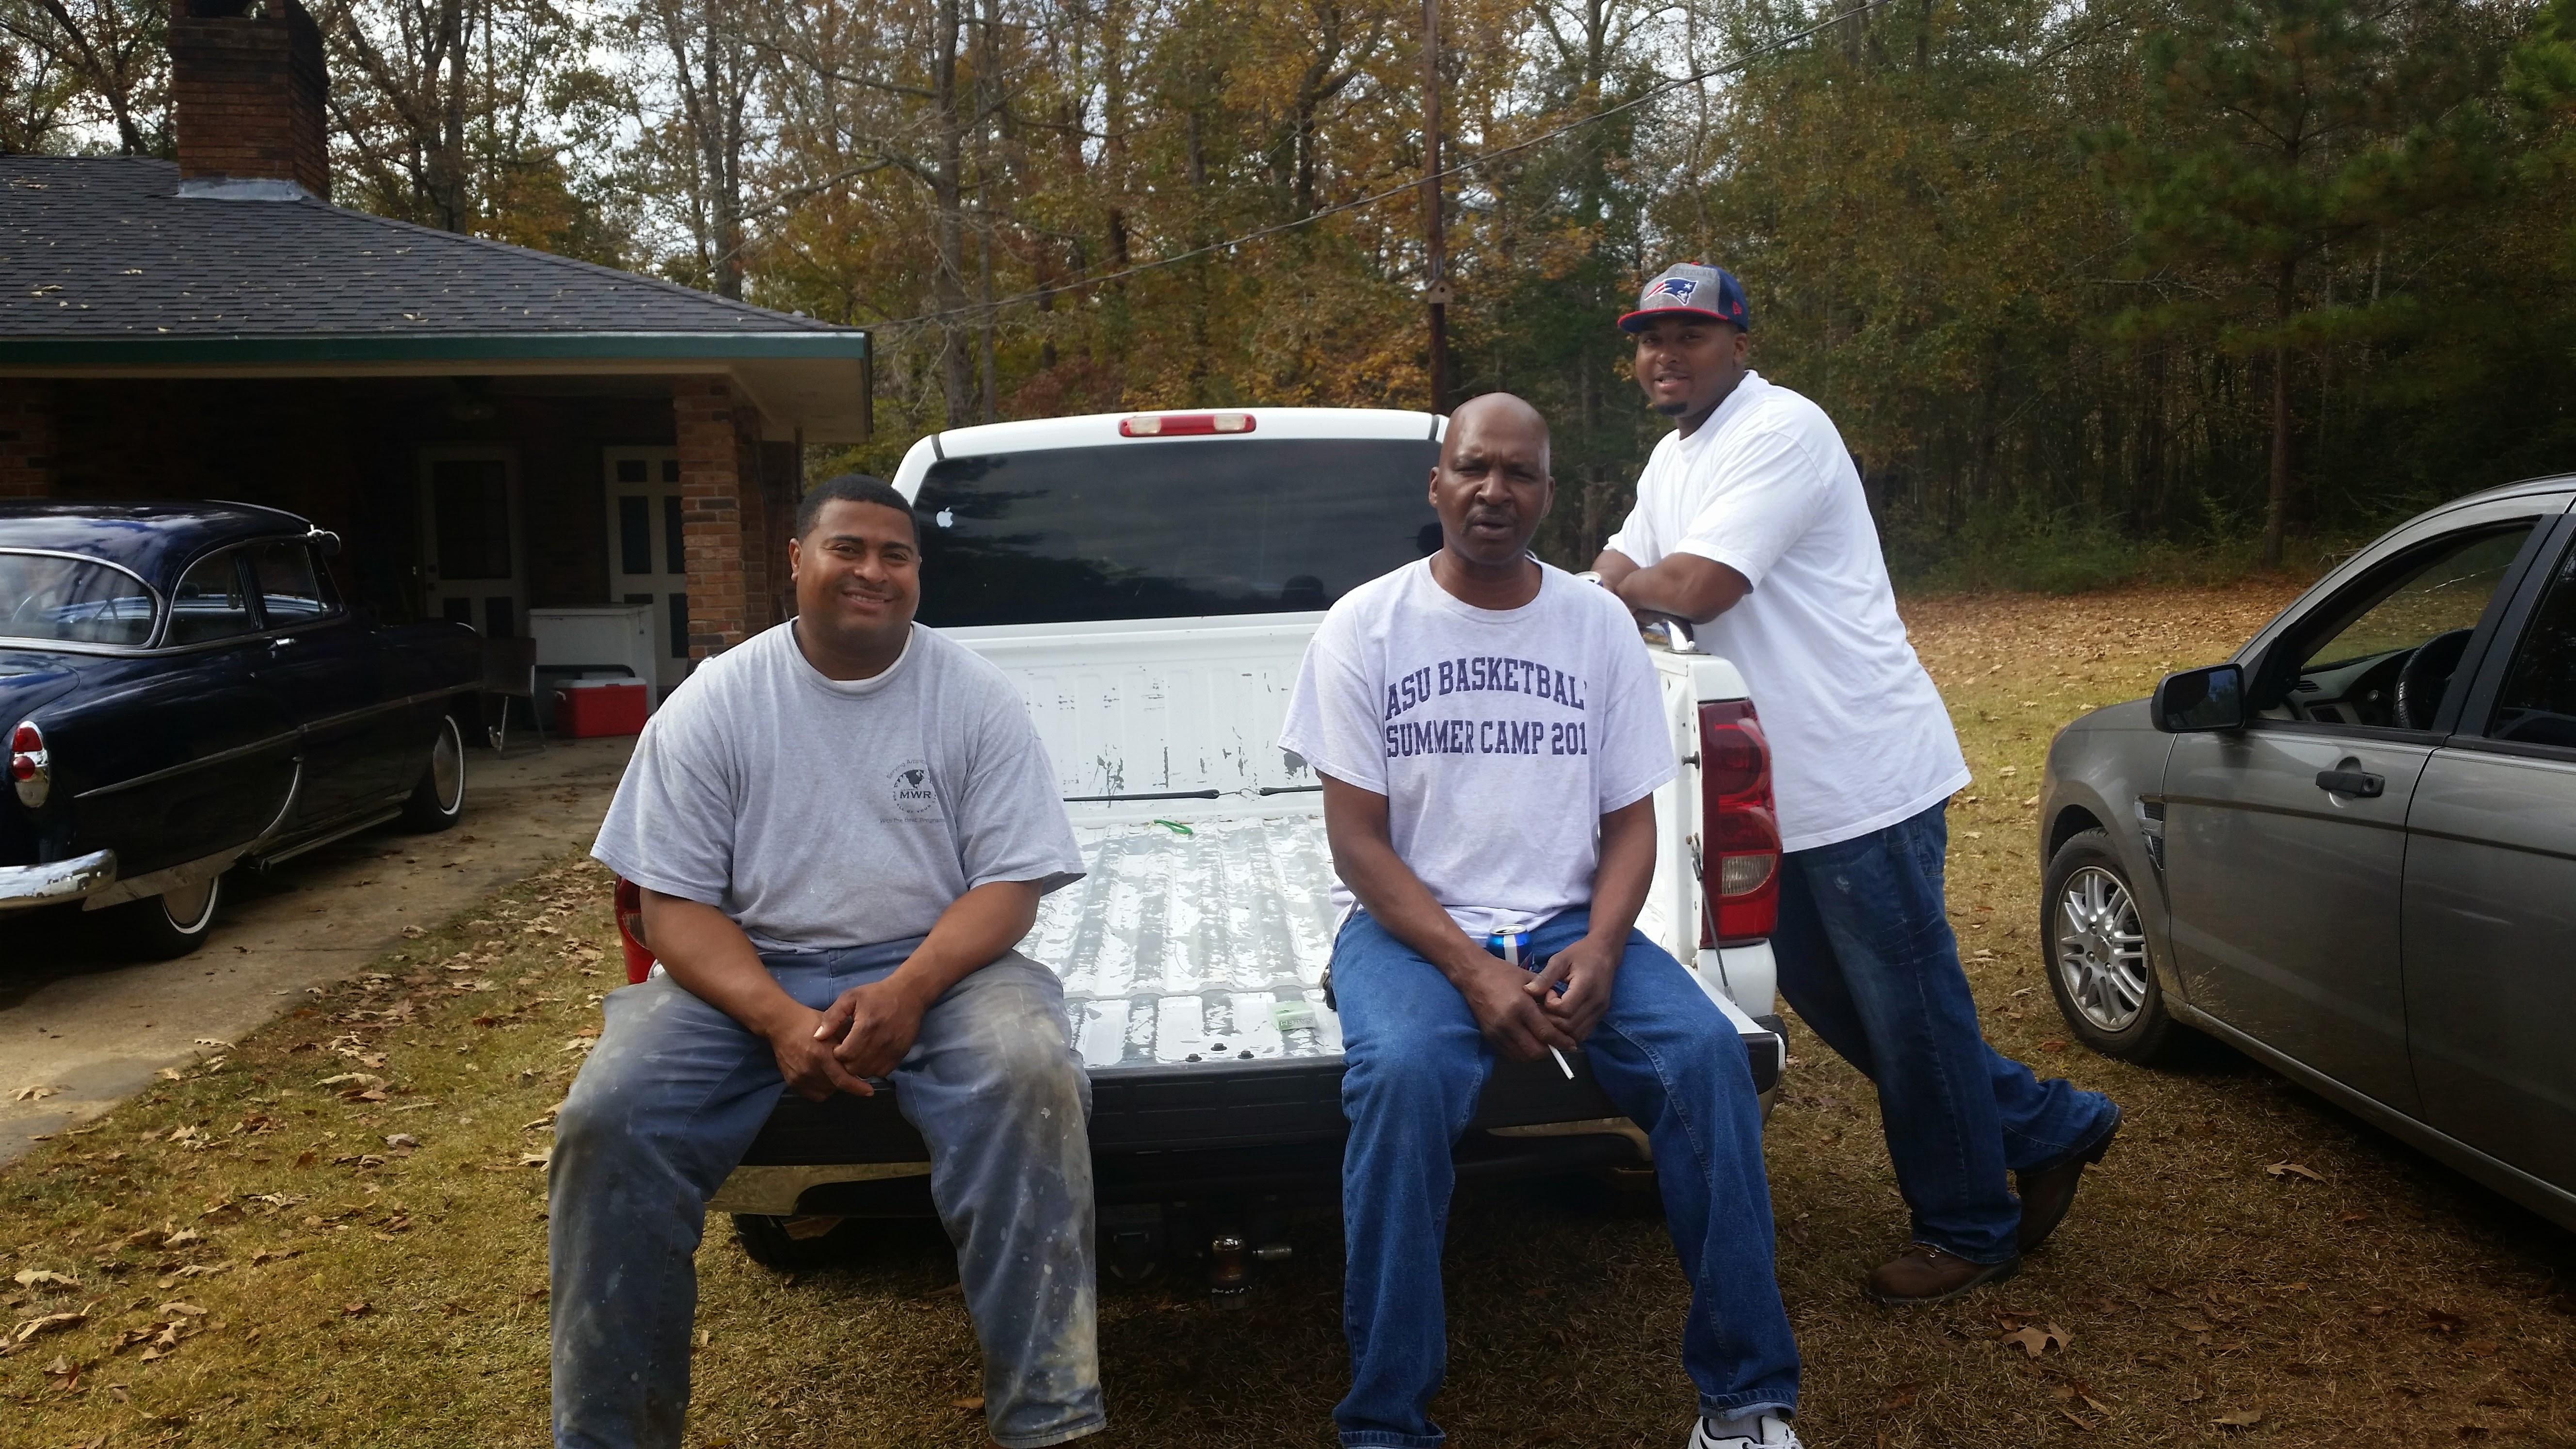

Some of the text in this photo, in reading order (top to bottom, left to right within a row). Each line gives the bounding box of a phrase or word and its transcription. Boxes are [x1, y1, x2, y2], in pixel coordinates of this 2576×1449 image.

[1385, 657, 1587, 721] ASU BASKETBAL
[1386, 720, 1473, 757] SUMMER
[1481, 721, 1544, 755] CAMP
[1280, 1017, 1313, 1026] SALEM
